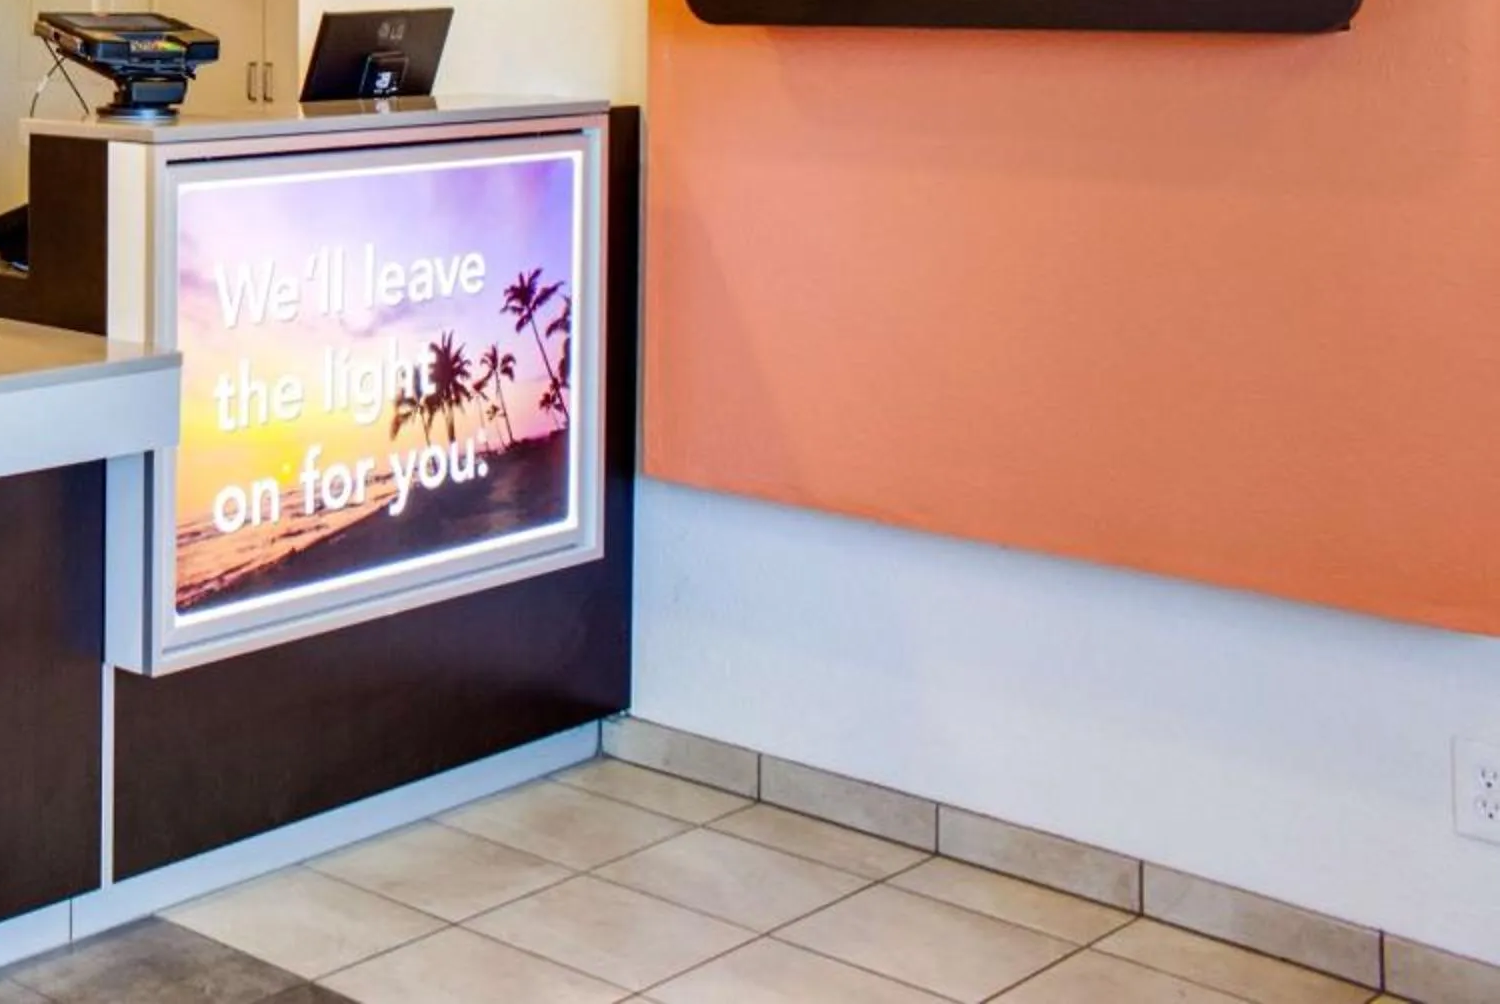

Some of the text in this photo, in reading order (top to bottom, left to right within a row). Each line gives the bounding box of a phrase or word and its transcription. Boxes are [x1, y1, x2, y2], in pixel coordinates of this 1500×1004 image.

[214, 243, 486, 329] We'll leave
[214, 339, 440, 431] the light
[213, 478, 280, 534] on
[299, 445, 376, 515] for
